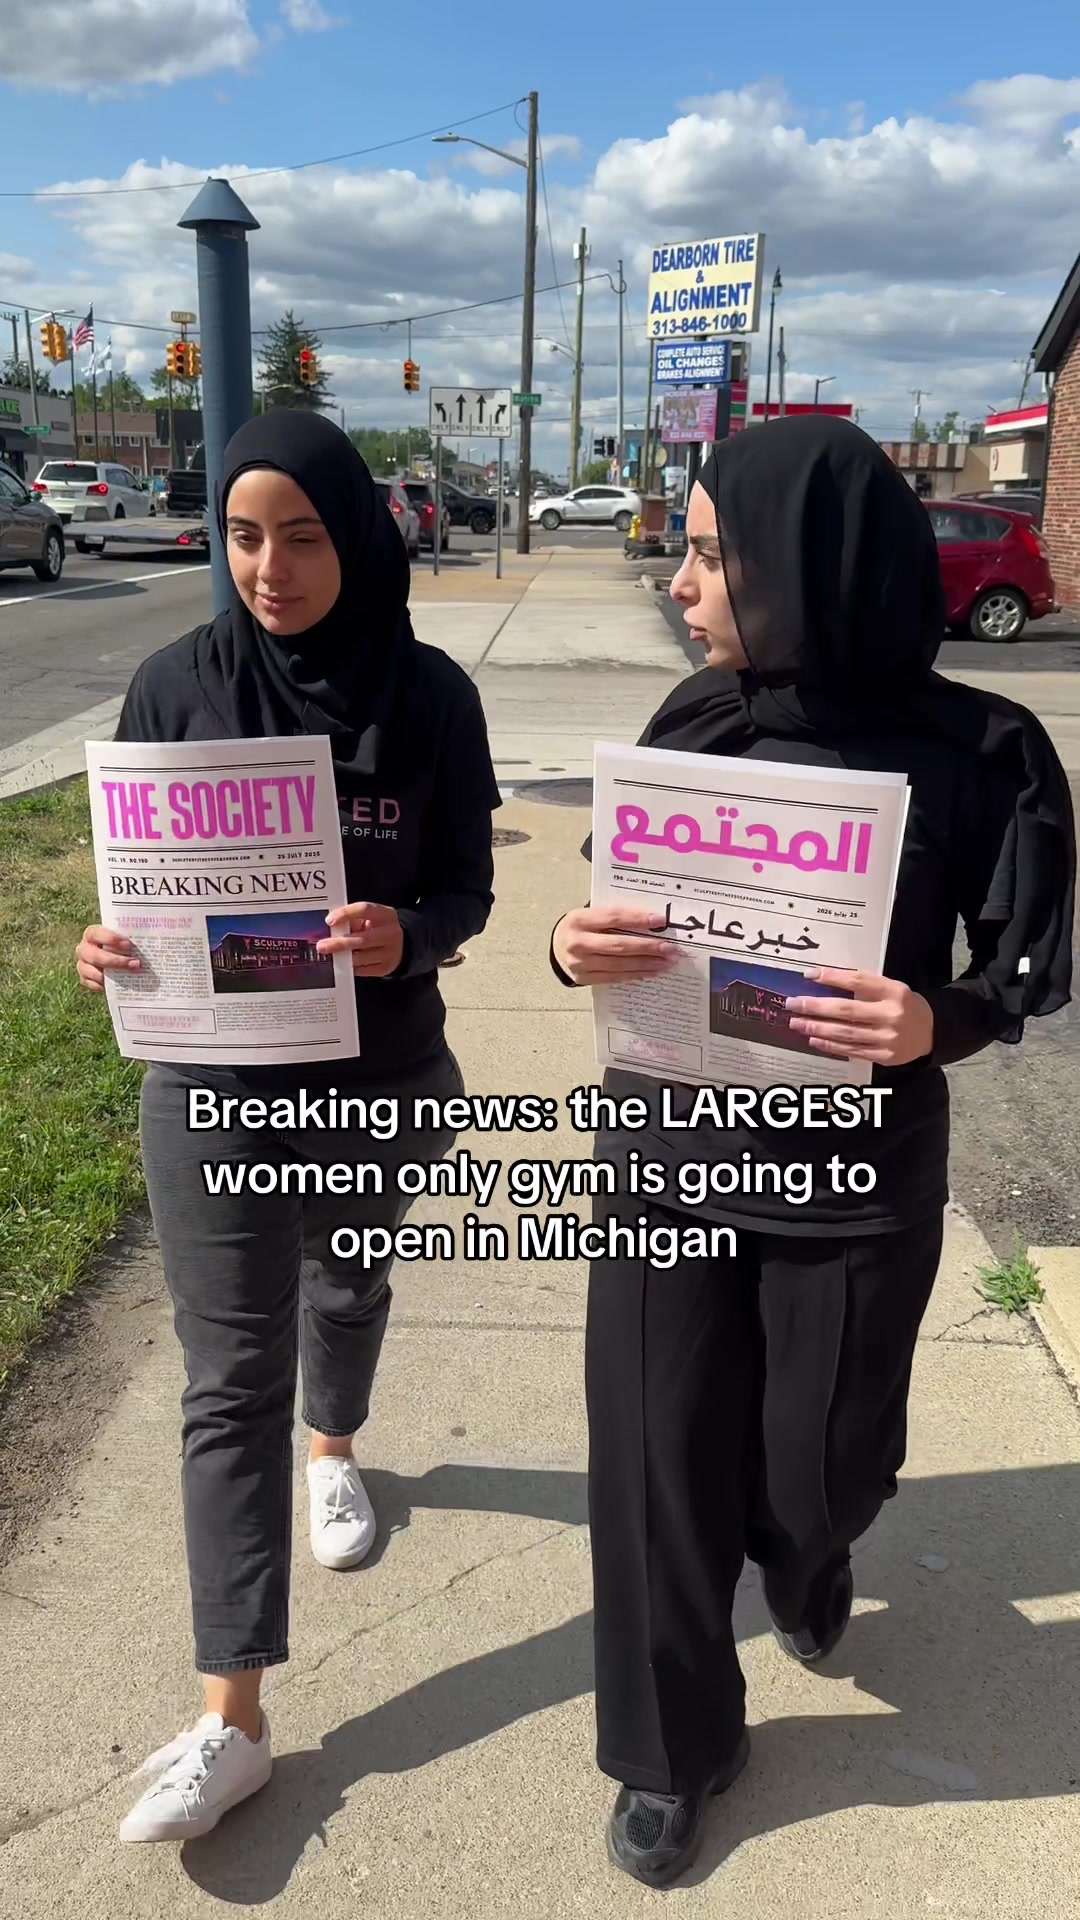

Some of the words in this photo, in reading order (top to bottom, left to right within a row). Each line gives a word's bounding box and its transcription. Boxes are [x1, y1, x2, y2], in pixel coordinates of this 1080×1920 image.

[652, 242, 720, 273] DEARBORN
[724, 238, 755, 264] TIRE
[696, 269, 704, 284] &
[651, 282, 752, 314] ALIGNMENT
[652, 312, 747, 335] 313-846-1000
[657, 347, 686, 359] COMPLETE
[686, 346, 702, 357] AUTO
[702, 345, 725, 356] SERVICE
[657, 359, 674, 369] OIL
[676, 356, 725, 368] CHANGES
[657, 368, 683, 380] BRAKES
[684, 367, 724, 378] ALIGNMENT
[102, 781, 162, 839] THE
[168, 775, 315, 840] SOCIETY
[353, 827, 371, 837] OF
[375, 829, 398, 840] LIFE
[610, 804, 872, 874] المجتمع
[110, 875, 244, 896] BREAKING
[251, 870, 327, 893] NEWS
[649, 902, 745, 940] عاجل
[816, 907, 832, 915] 2026
[254, 938, 298, 947] SCULPTED
[746, 925, 820, 954] خبر
